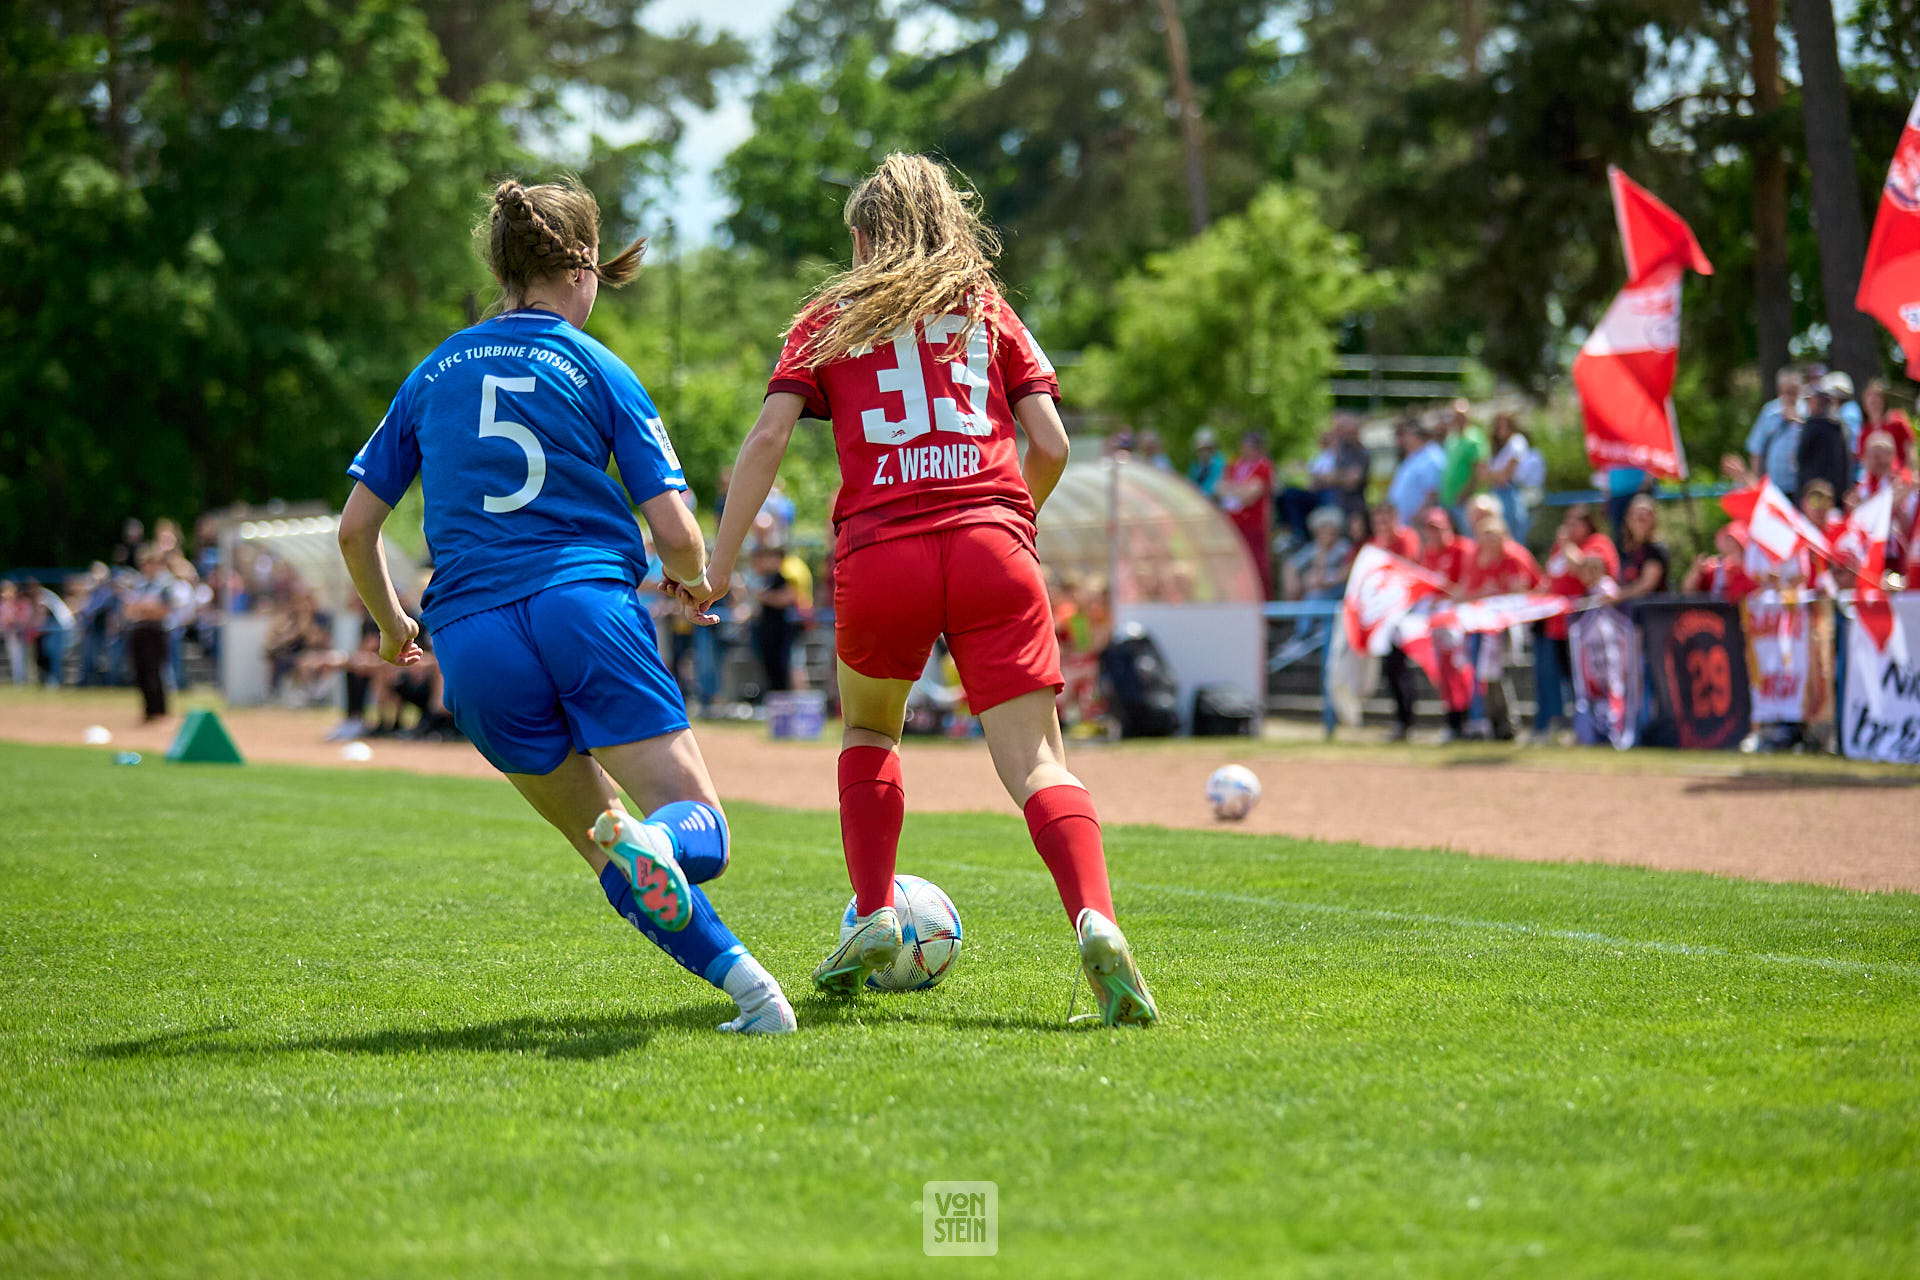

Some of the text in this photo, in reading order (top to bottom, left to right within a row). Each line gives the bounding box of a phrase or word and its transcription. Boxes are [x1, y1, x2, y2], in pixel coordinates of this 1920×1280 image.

[424, 345, 589, 390] 1. FFC TURBINE POTSDAM
[850, 314, 993, 446] 33
[478, 374, 547, 514] 5
[872, 443, 981, 486] Z. WERNER
